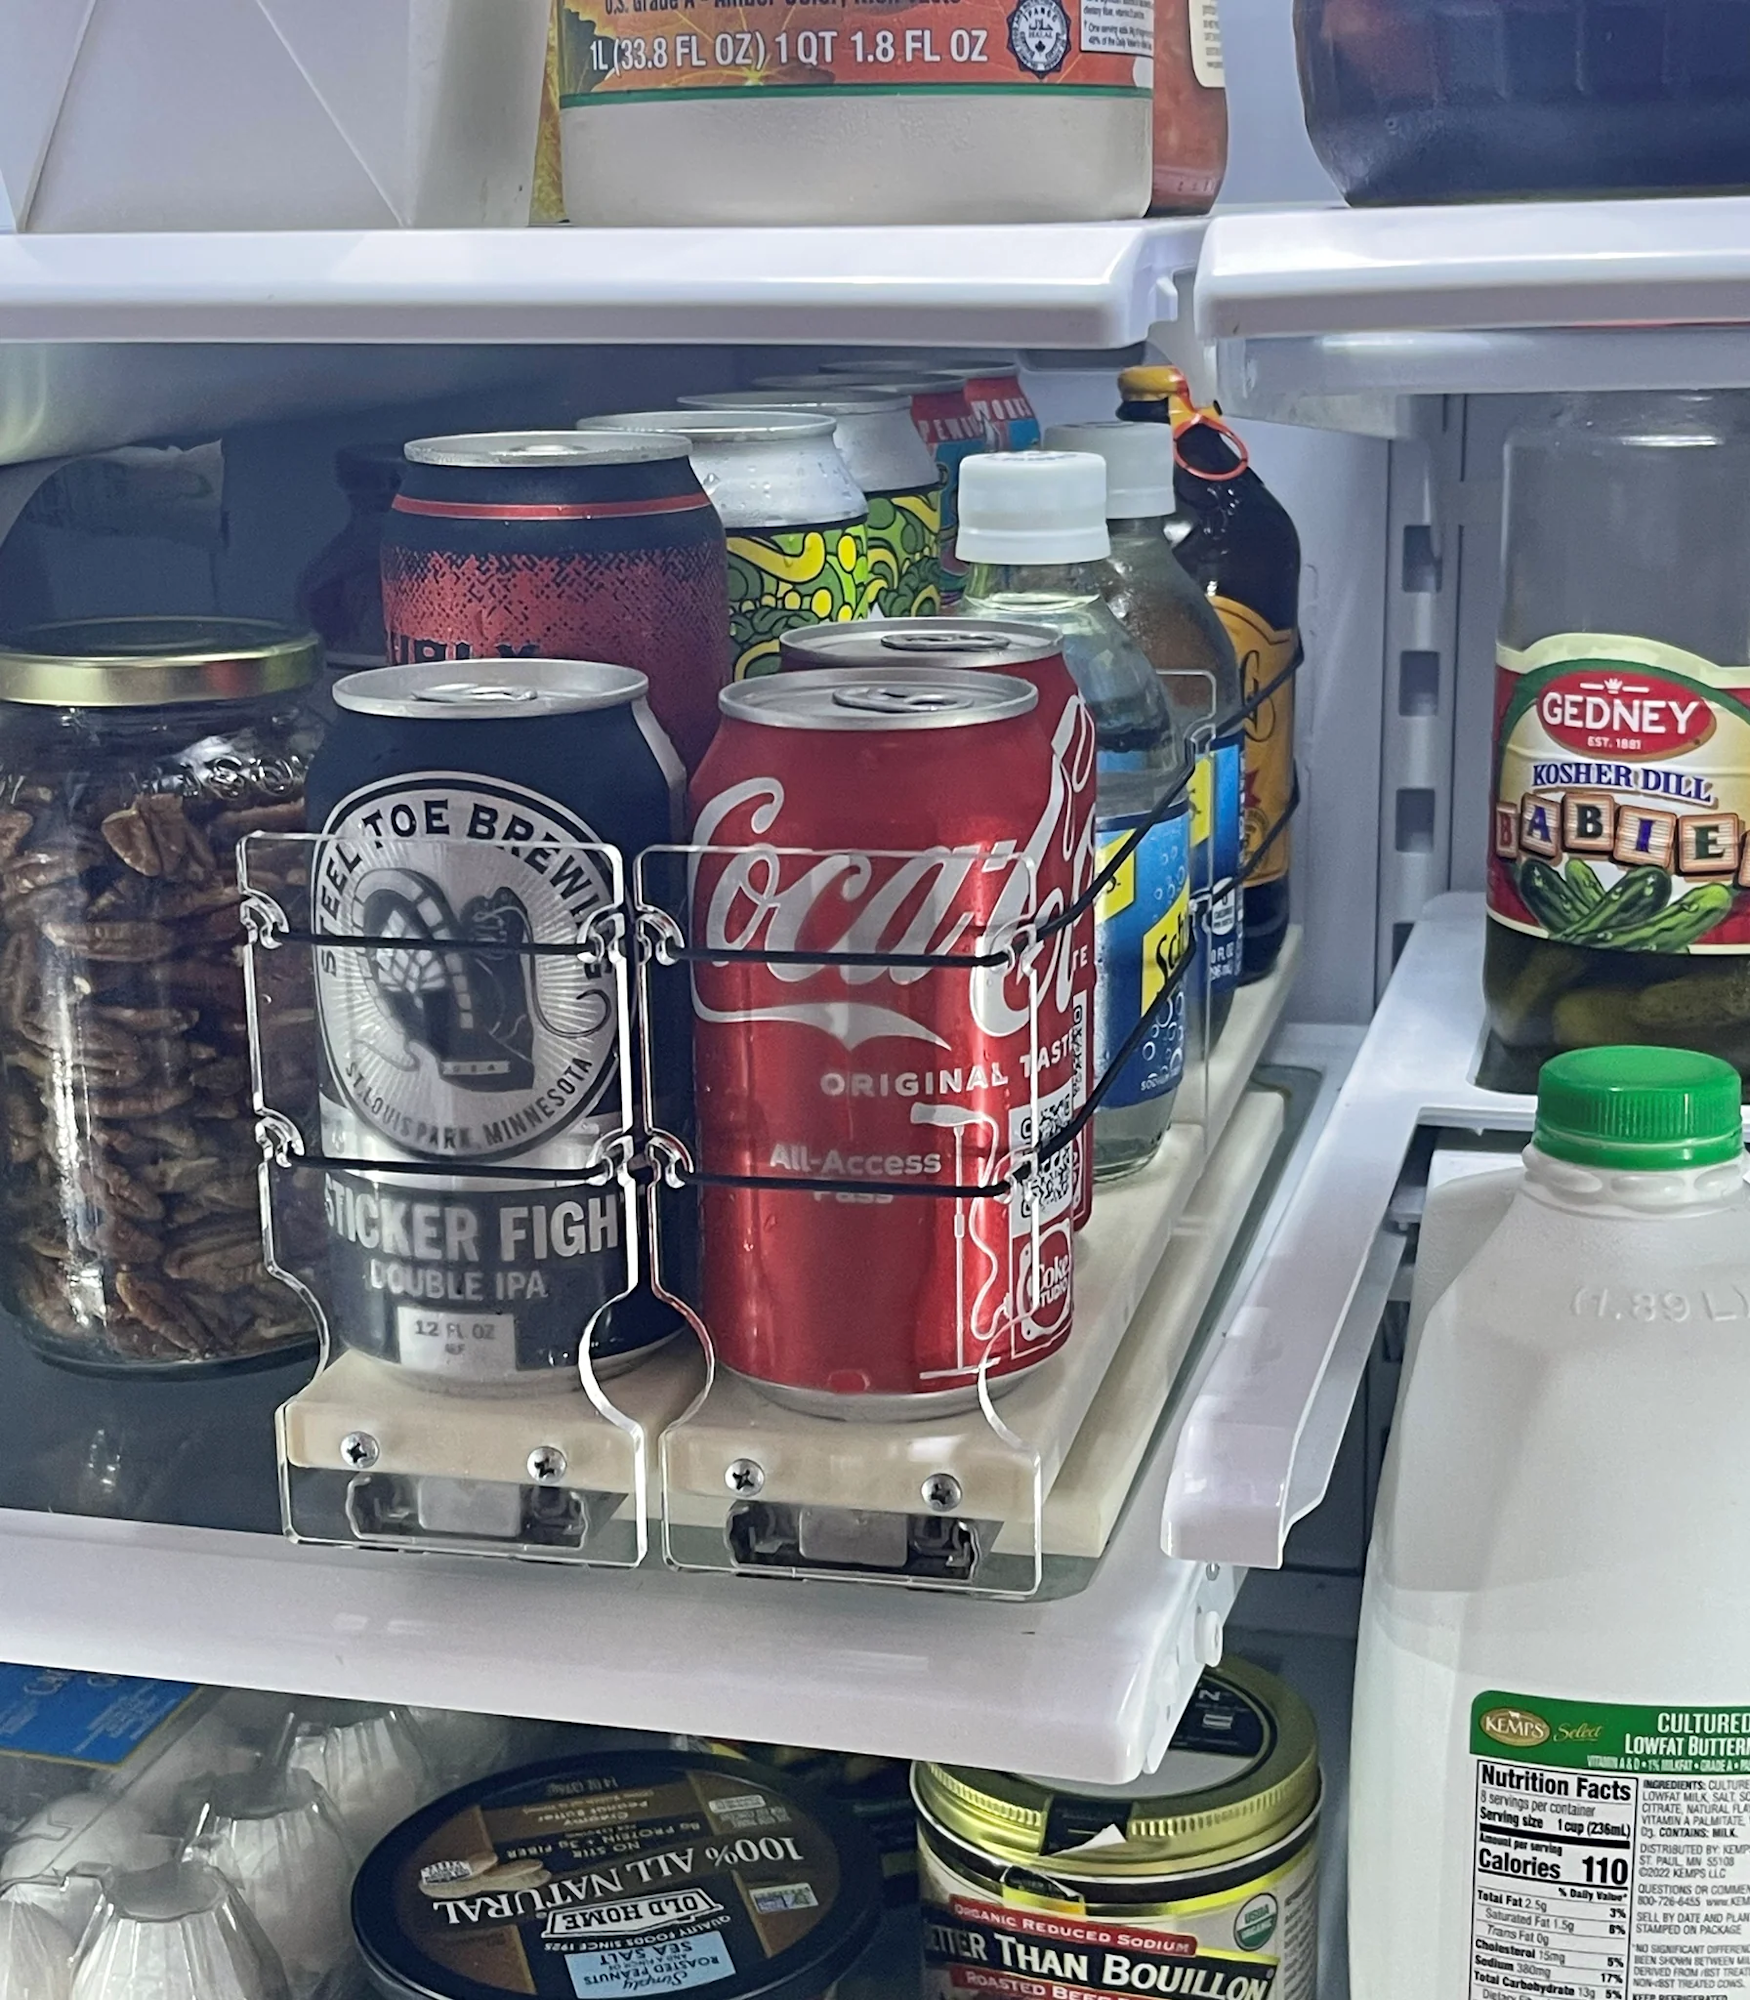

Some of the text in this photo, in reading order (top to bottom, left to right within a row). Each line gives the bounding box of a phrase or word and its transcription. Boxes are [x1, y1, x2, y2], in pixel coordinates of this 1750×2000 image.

[590, 40, 608, 71] 1L
[614, 37, 669, 77] (33.8
[676, 35, 706, 67] FL
[715, 31, 765, 71] OZ)
[775, 33, 788, 64] 1
[797, 31, 838, 66] QT
[851, 30, 895, 63] 1.8
[905, 29, 941, 63] FL
[950, 29, 988, 62] OZ
[1542, 691, 1699, 735] GEDNEY
[1587, 736, 1612, 748] EST.
[1533, 763, 1711, 802] KOSHER DILL
[363, 799, 450, 849] TOE
[820, 1063, 1009, 1098] ORIGINAL
[483, 1056, 594, 1147] MINNESOTA
[770, 1143, 942, 1177] All-Access
[324, 1172, 645, 1262] STICKER FIGH
[370, 1257, 549, 1301] DOUBLE IPA
[415, 1321, 440, 1337] 12
[1485, 1716, 1604, 1742] KEMPS Select
[1482, 1764, 1631, 1801] Nutrition Facts
[590, 1801, 648, 1812] Peanut
[1489, 1793, 1596, 1817] servings per container
[1643, 1791, 1680, 1801] LOWFAT
[563, 1811, 628, 1827] Creamy
[1641, 1815, 1681, 1825] VITAMIN
[1687, 1804, 1729, 1814] NATURAL
[1480, 1806, 1631, 1840] Serving size cup (236mL)
[507, 1826, 675, 1859] PROTEIN FIBER
[613, 1842, 641, 1852] NO
[705, 1837, 804, 1867] 100%
[1480, 1833, 1563, 1857] Amount per serving
[1640, 1844, 1703, 1854] DISTRIBUTED
[626, 1848, 694, 1883] ALL
[1479, 1848, 1629, 1885] Calories 110
[1673, 1868, 1706, 1879] KEMPS
[1708, 1868, 1727, 1878] LLC
[1686, 1857, 1701, 1866] MN
[433, 1867, 625, 1925] NATURAL
[1558, 1887, 1567, 1897] %
[1570, 1889, 1594, 1901] Daily
[1638, 1883, 1708, 1894] QUESTIONS OR
[562, 1895, 698, 1930] OLD HOME
[1477, 1890, 1627, 1919] Total Fat 2.5g 3%
[1636, 1911, 1723, 1923] SELL BY DATE AND
[678, 1915, 731, 1938] QUALITY
[954, 1903, 1190, 1953] ORGANIC REDUCED SODIUM
[1485, 1908, 1575, 1933] Saturated Fat 1.5g
[1636, 1924, 1742, 1935] STAMPED ON PACKAGE
[579, 1939, 622, 1950] SINCE
[626, 1930, 676, 1947] FOODS
[1487, 1924, 1549, 1946] Trans Fat 0g
[600, 1940, 693, 1966] SEA SALT
[1475, 1939, 1624, 1968] Cholesterol 15mg 5%
[1634, 1955, 1735, 1966] BEEN SHOWN BETWEEN
[1651, 1945, 1705, 1954] SIGNIFICANT
[584, 1956, 720, 1985] ROASTED PEANUTS
[993, 1932, 1088, 1982] THAN
[1102, 1953, 1268, 2000] BOUILLON
[1475, 1955, 1623, 1984] Sodium 380mg 17%
[1634, 1966, 1698, 1977] DERIVED FROM
[623, 1970, 689, 1991] Simply
[966, 1971, 1046, 1996] ROASTED
[1474, 1971, 1622, 2000] Total Carbohydrate 13g 5%
[1677, 1979, 1715, 1988] TREATED
